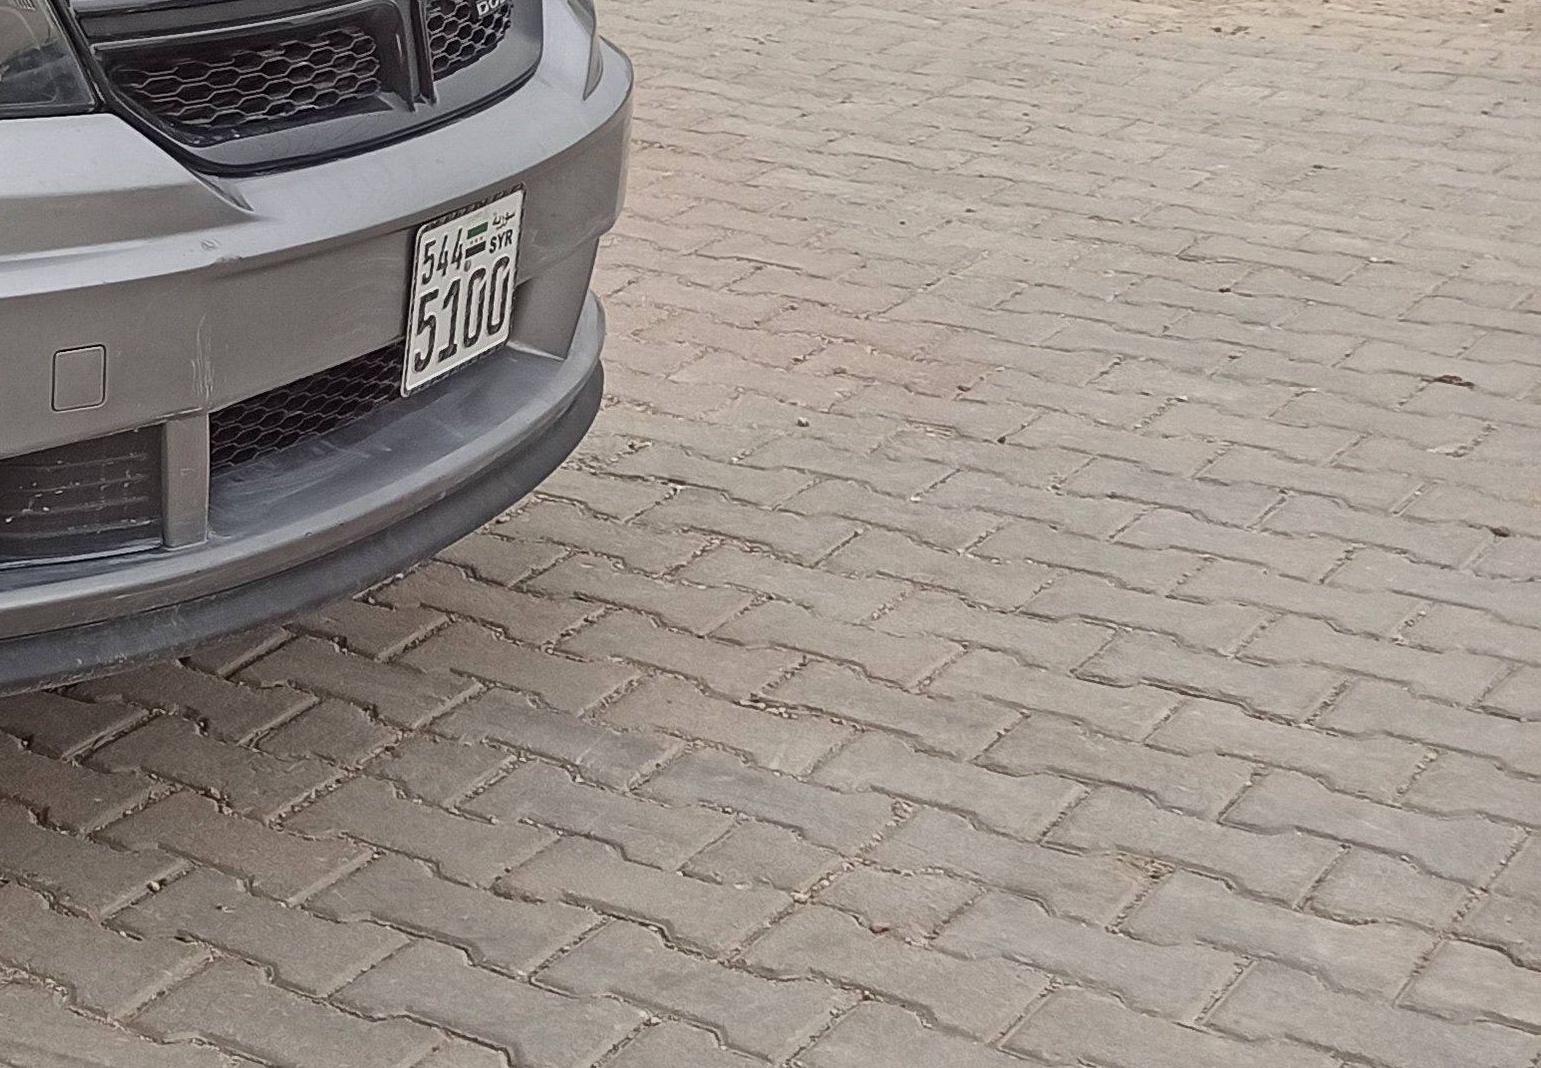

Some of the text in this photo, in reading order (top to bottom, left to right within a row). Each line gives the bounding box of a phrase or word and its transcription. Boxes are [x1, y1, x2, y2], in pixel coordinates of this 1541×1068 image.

[492, 211, 515, 230] سورية
[421, 228, 464, 285] 544
[489, 229, 513, 254] SYR
[415, 256, 510, 372] 5100
